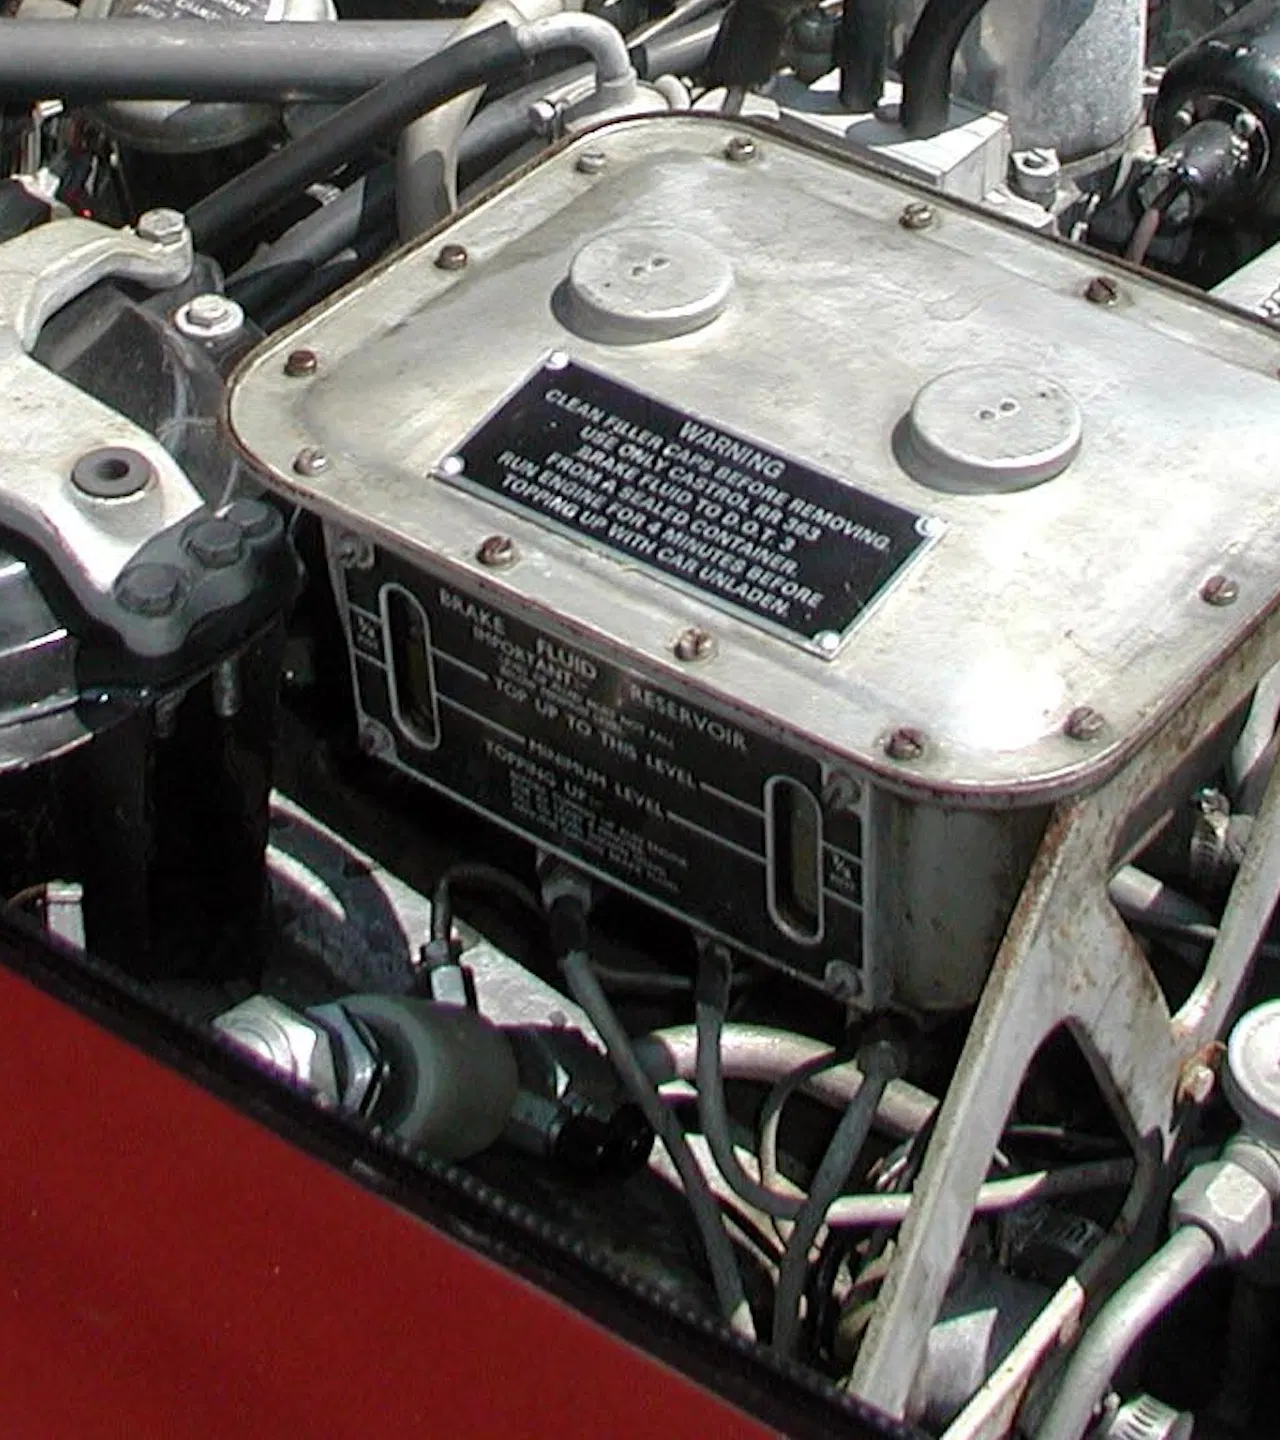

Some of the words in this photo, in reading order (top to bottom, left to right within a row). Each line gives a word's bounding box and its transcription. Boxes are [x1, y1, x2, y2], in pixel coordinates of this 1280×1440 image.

[541, 387, 608, 423] CLEAN
[600, 414, 668, 451] FILLER
[659, 441, 717, 474] CAPS
[710, 465, 790, 507] BEFORE
[542, 452, 604, 486] FROM
[598, 477, 622, 494] A
[615, 485, 693, 526] SEALED
[573, 445, 642, 481] BRAKE
[635, 473, 696, 506] FLUID
[689, 497, 724, 519] TO
[775, 536, 799, 553] 3
[576, 426, 620, 451] USE
[613, 442, 671, 474] ONLY
[664, 464, 758, 512] CASTROL
[750, 503, 786, 525] RR
[778, 515, 824, 543] 363
[673, 420, 790, 480] WARNING
[494, 451, 541, 478] RUN
[534, 469, 609, 509] ENGINE
[603, 501, 649, 528] FOR
[642, 519, 664, 535] 4
[657, 526, 748, 574] MINUTES
[743, 564, 826, 609] BEFORE
[496, 473, 582, 519] TOPPING
[576, 510, 611, 532] UP
[604, 523, 659, 555] WITH
[654, 546, 701, 574] CAR
[439, 587, 505, 636] BRAKE
[535, 637, 597, 680] FLUID
[629, 683, 748, 754] RESERVOIR
[494, 676, 528, 703] TOP
[534, 696, 560, 721] UP
[568, 711, 594, 738] TO
[645, 752, 697, 790] LEVEL
[614, 781, 665, 821] LEVEL
